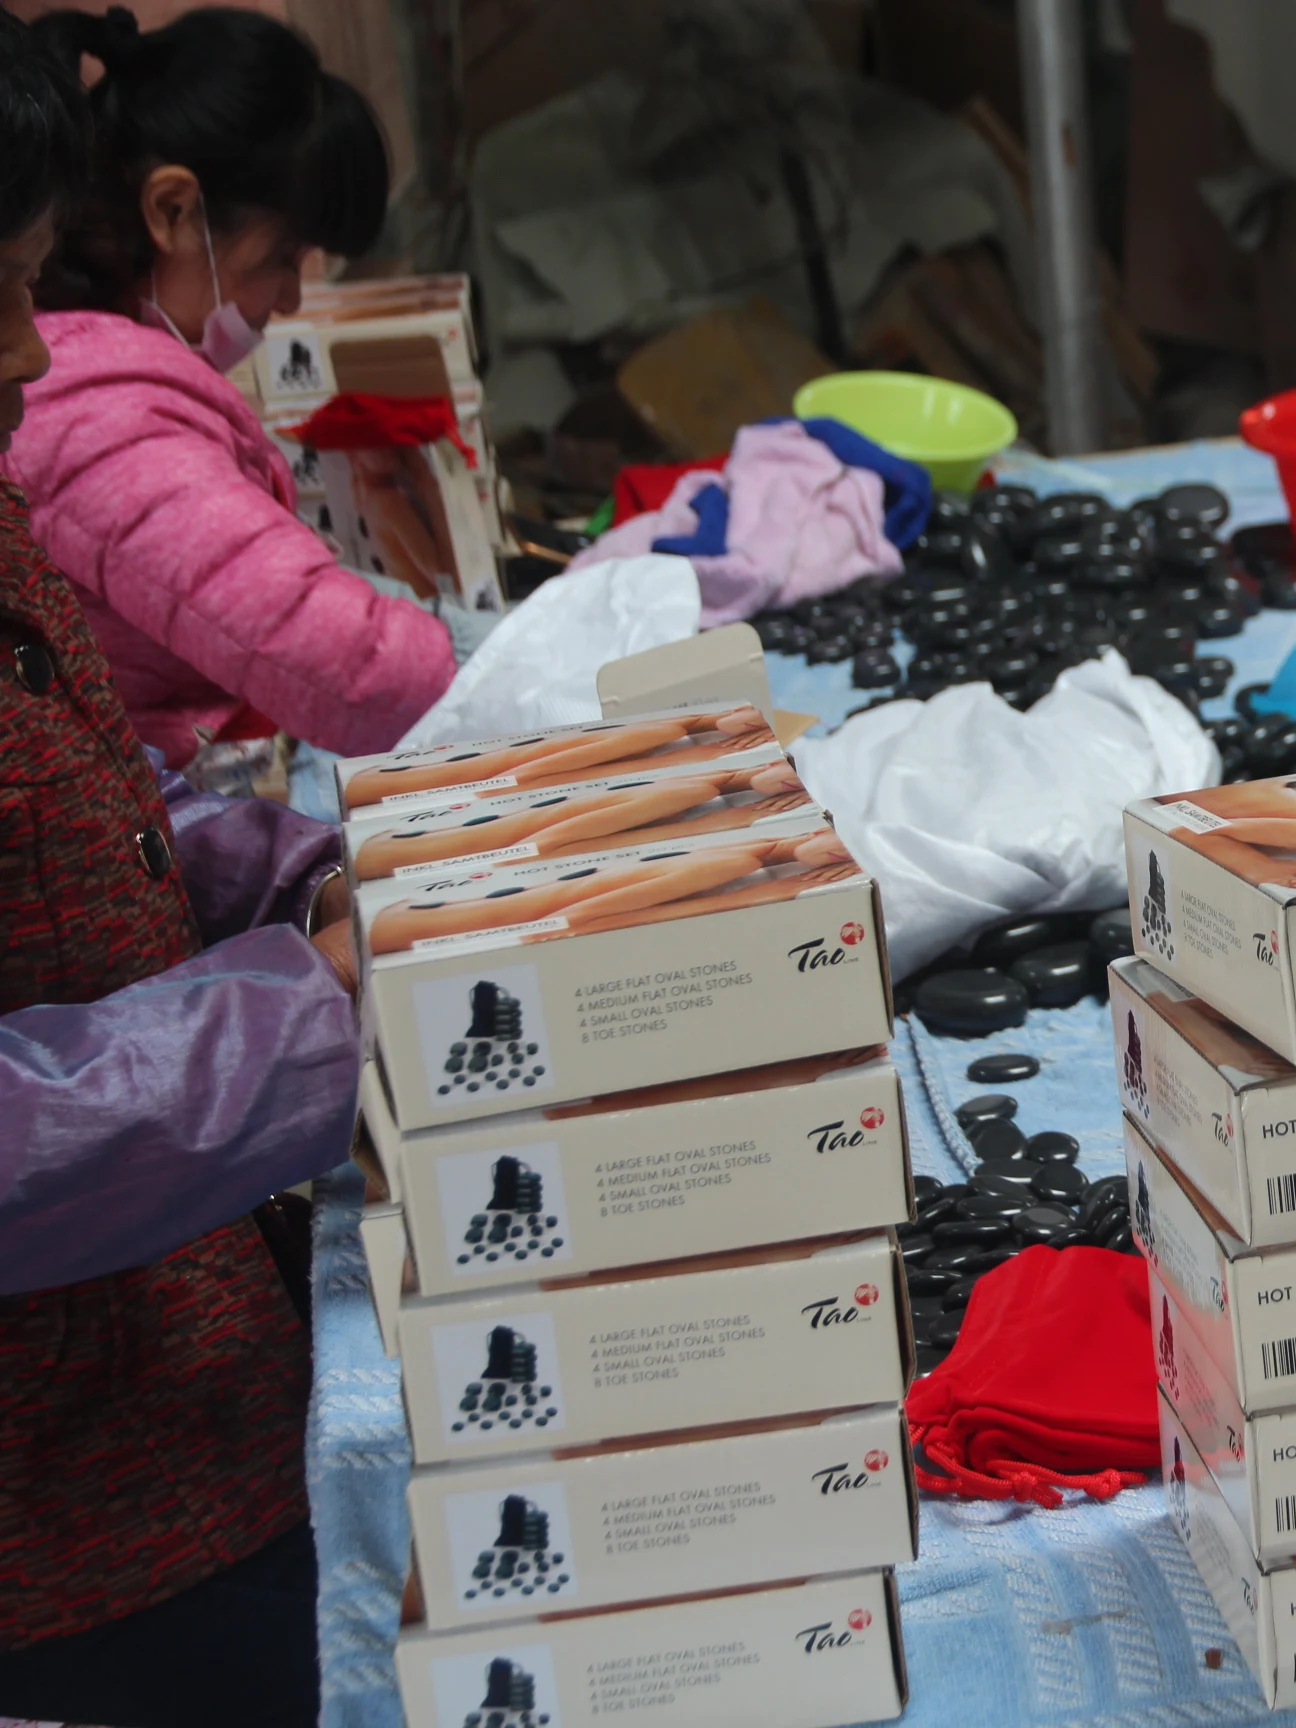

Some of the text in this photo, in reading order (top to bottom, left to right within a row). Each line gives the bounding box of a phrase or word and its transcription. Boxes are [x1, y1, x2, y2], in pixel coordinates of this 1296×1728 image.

[788, 938, 845, 973] Tao
[1253, 933, 1274, 965] Tao
[575, 961, 737, 997] 4 LARGE FLAT OVAL STONES
[577, 973, 753, 1012] 4 MEDIUM FLAT OVAL STONES
[580, 996, 713, 1027] 4 SMALL OVAL STONES
[581, 1020, 667, 1043] 8 TOE STONES
[807, 1120, 864, 1153] Tao
[1262, 1120, 1296, 1139] HOT
[595, 1141, 756, 1173] 4 LARGE FLAT OVAL STONES
[597, 1153, 771, 1187] 4 MEDIUM FLAT OVAL STONES
[599, 1173, 731, 1202] 4 SMALL OVAL STONES
[601, 1195, 685, 1217] 8 TOE STONES
[1258, 1287, 1292, 1305] HOT
[801, 1296, 858, 1329] Tao
[812, 1462, 868, 1494] Tao
[796, 1622, 852, 1653] Tao
